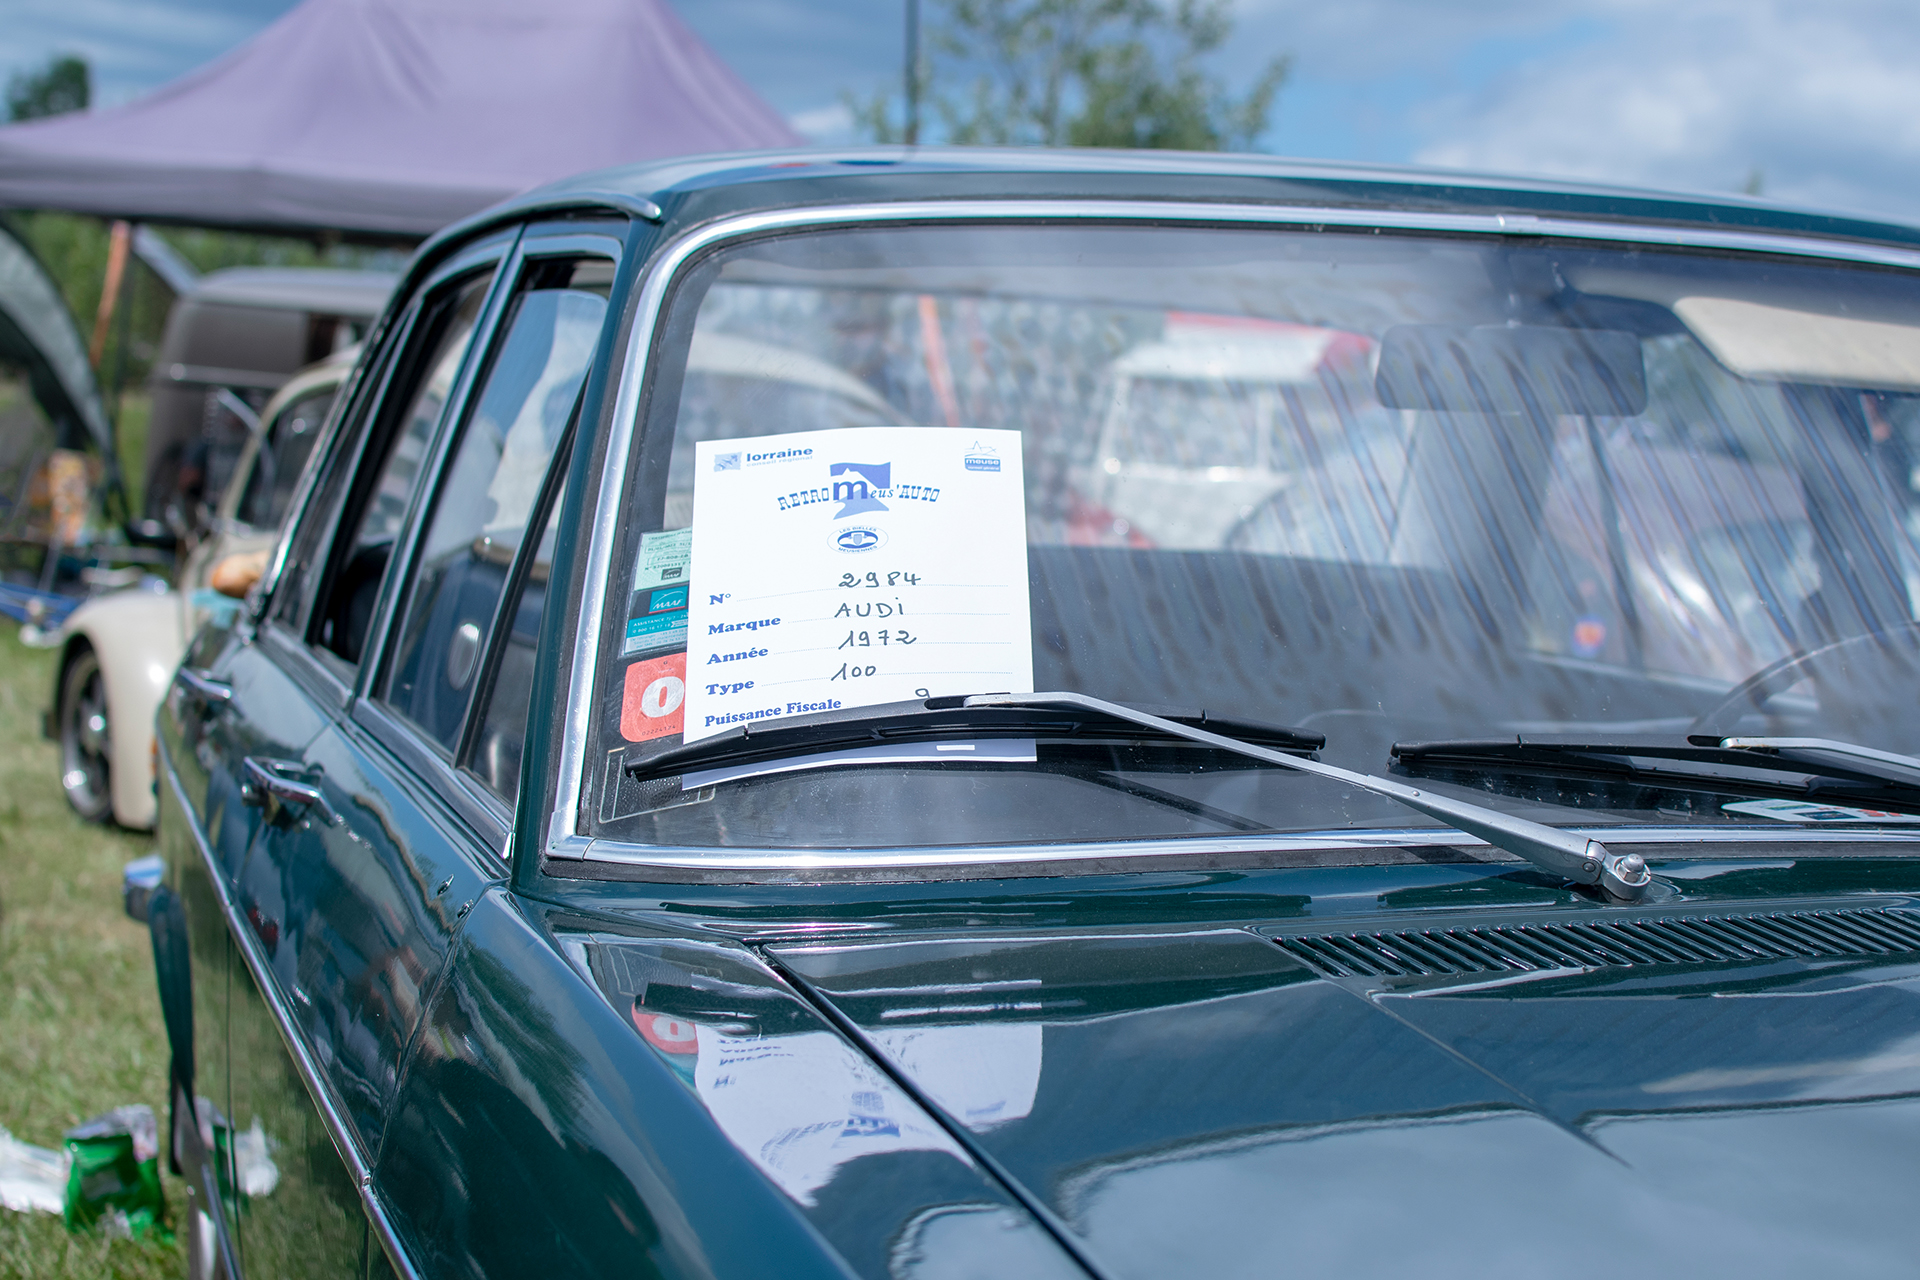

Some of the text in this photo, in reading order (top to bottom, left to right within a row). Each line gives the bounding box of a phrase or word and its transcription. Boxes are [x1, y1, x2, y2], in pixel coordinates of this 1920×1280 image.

[746, 448, 813, 462] lorraine
[746, 459, 776, 467] conseil
[777, 487, 829, 511] RETRO
[838, 571, 922, 588] 2984
[652, 599, 684, 610] MAAF
[709, 593, 732, 605] N°
[633, 617, 665, 627] ASSISTANCE
[708, 617, 781, 635] Marque
[838, 629, 917, 650] 1972
[706, 647, 769, 665] Année
[830, 662, 877, 681] 100
[705, 680, 755, 695] Type
[704, 699, 842, 727] Puissance Fiscale
